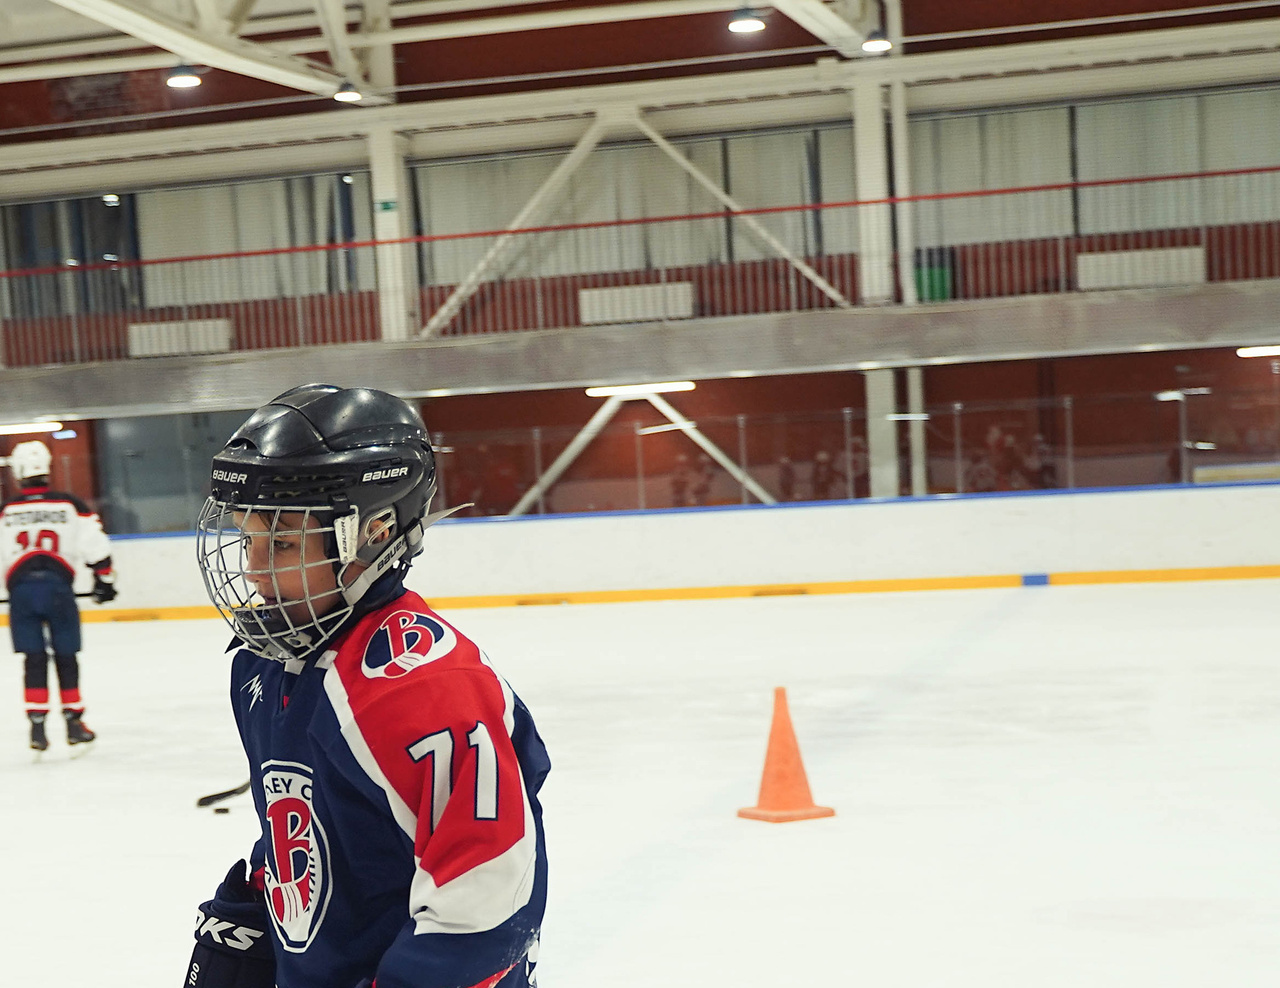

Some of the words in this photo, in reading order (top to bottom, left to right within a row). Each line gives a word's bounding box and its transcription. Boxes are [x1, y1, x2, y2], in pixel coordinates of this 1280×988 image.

[212, 469, 247, 485] BAUER
[362, 466, 409, 482] BAUER
[266, 778, 293, 795] EY
[406, 721, 500, 837] 71
[195, 908, 264, 951] OKS
[188, 962, 200, 987] 100
